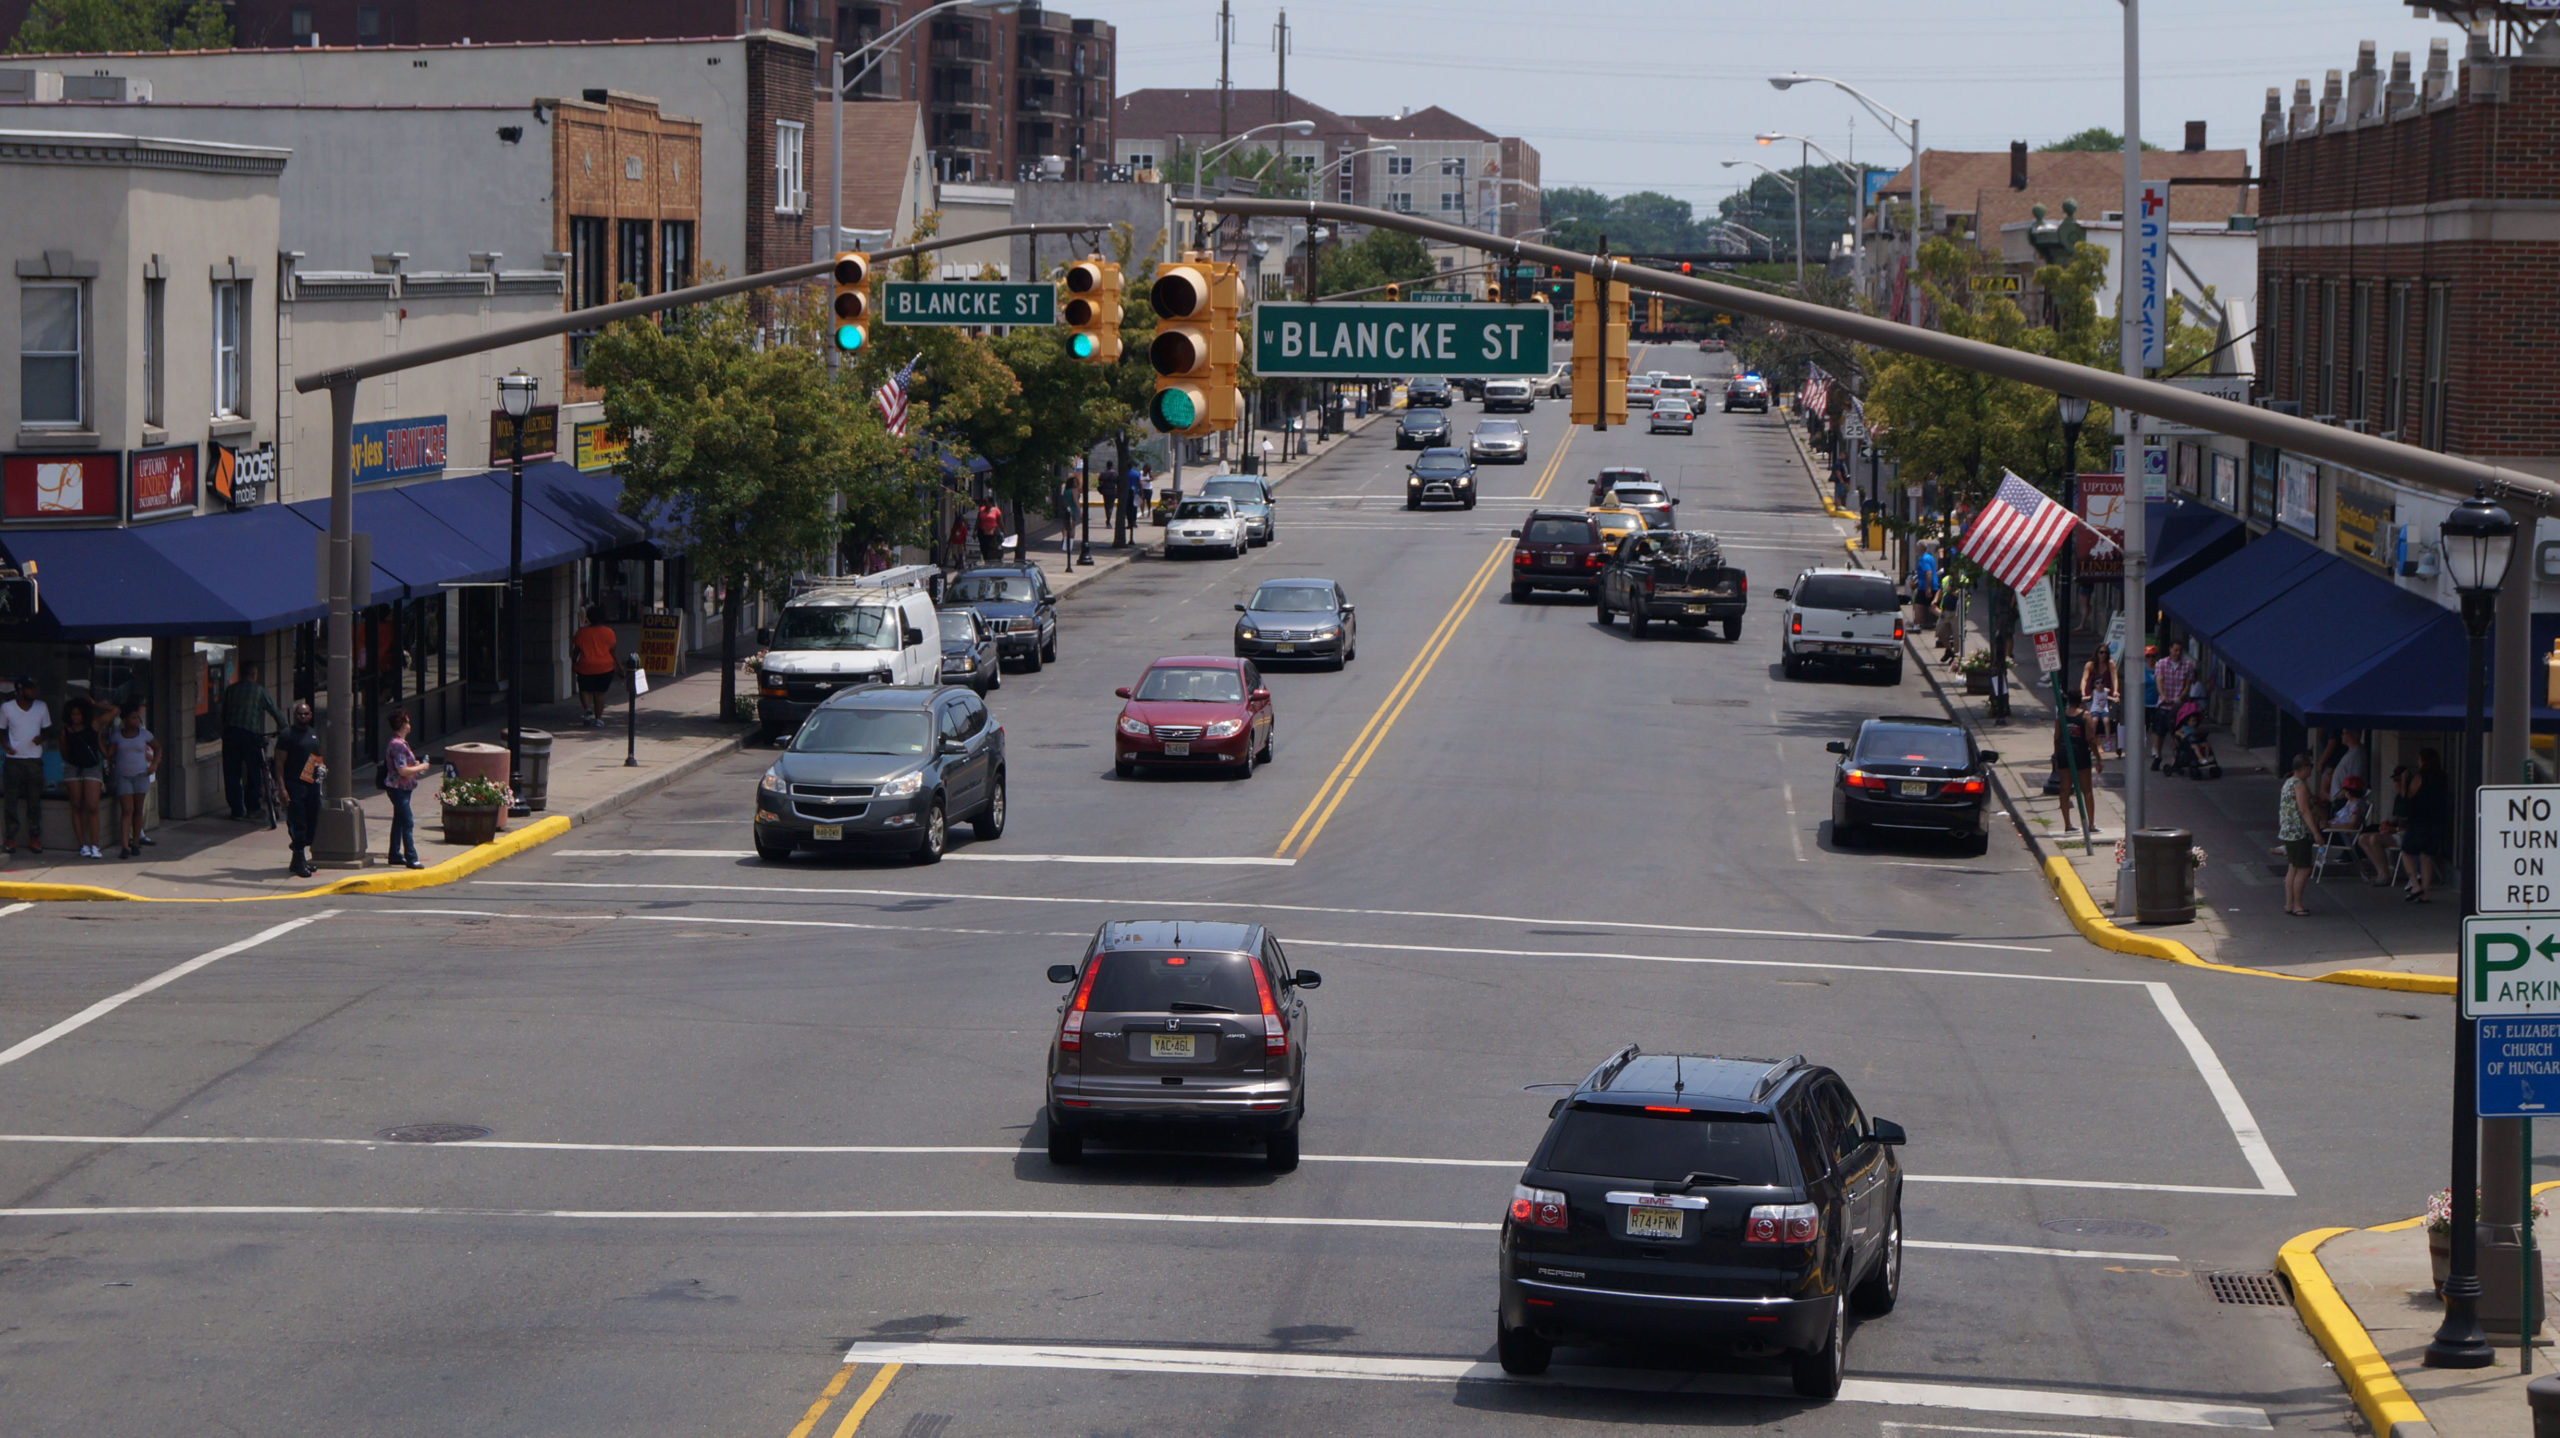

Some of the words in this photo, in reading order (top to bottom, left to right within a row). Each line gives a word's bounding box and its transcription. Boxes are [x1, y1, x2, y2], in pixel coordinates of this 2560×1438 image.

[899, 292, 1001, 316] BLANCKE
[1015, 293, 1040, 316] ST
[1263, 330, 1274, 345] W
[1281, 321, 1457, 360] BLANCKE
[1481, 323, 1525, 361] ST
[1846, 426, 1864, 436] 25
[386, 423, 446, 473] FURNITURE
[139, 456, 168, 478] UPTOWN
[235, 444, 274, 485] boost
[139, 474, 168, 498] LINDEN
[235, 485, 257, 505] mobile
[2083, 482, 2125, 493] UPTOW
[646, 616, 677, 628] OPEN
[2508, 798, 2552, 822] NO
[2499, 830, 2559, 849] TURN
[2514, 857, 2544, 876] ON
[2507, 884, 2551, 904] RED
[2482, 1025, 2502, 1039] ST.
[2502, 1042, 2553, 1057] CHURCH
[2487, 1061, 2505, 1075] OF
[1638, 1196, 1674, 1207] GMC
